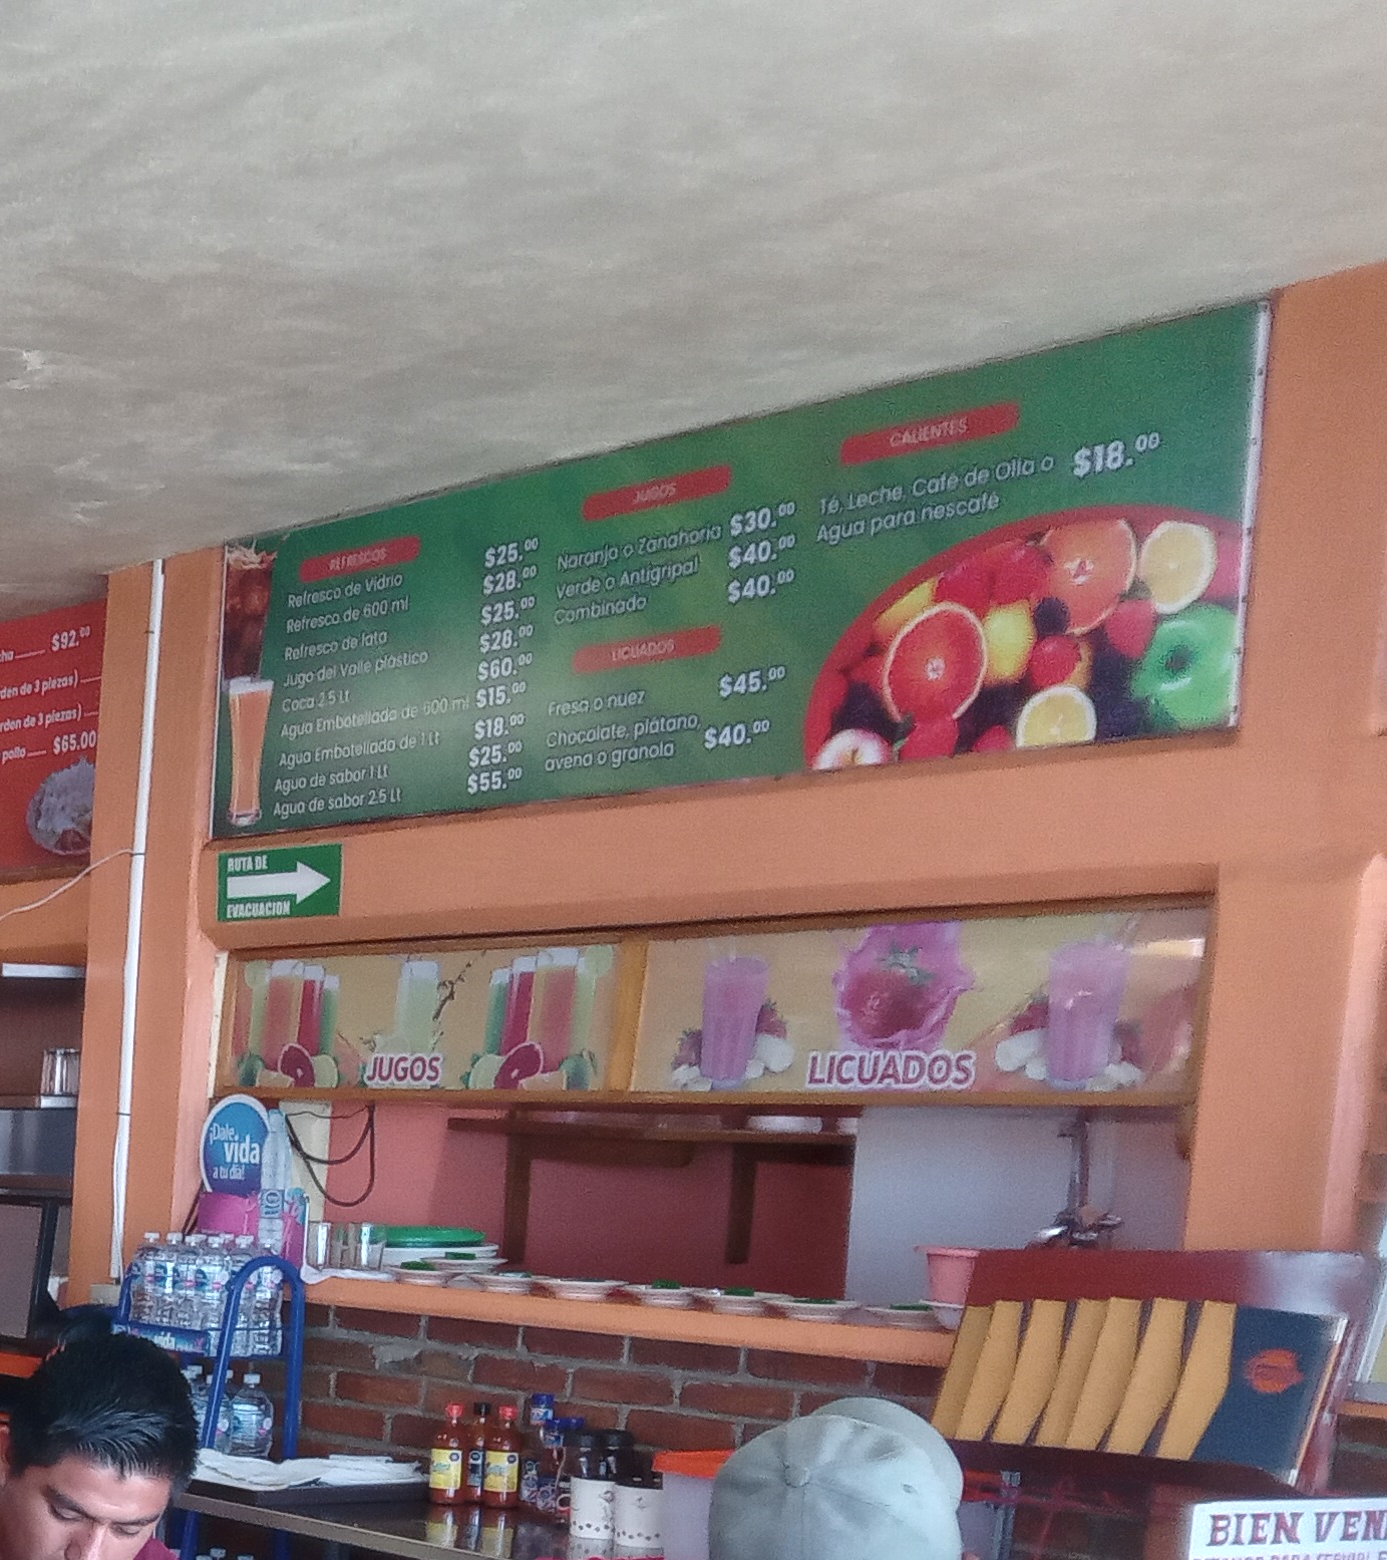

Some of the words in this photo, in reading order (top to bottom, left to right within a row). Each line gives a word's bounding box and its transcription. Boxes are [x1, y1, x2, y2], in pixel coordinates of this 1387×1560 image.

[890, 417, 968, 447] CALIENTES
[912, 471, 960, 497] Café
[964, 467, 989, 487] de
[995, 457, 1036, 482] Olla
[1040, 455, 1055, 472] o
[633, 483, 678, 503] JUGOS
[730, 501, 796, 537] $30.00
[816, 520, 866, 546] Agua
[870, 512, 916, 535] para
[920, 492, 1000, 523] nescafé
[484, 537, 539, 569] $25.00
[557, 545, 619, 571] Naranja
[622, 544, 633, 558] o
[637, 524, 722, 554] Zanahoria
[728, 534, 796, 570] $40.00
[287, 586, 342, 608] Refresco
[345, 583, 361, 597] de
[364, 573, 403, 593] Vidrio
[556, 576, 601, 599] Verde
[605, 576, 616, 591] o
[619, 557, 699, 587] Antigripal
[727, 569, 795, 604] $40.00
[286, 613, 339, 634] Refresco
[344, 607, 360, 621] de
[363, 598, 388, 618] 600
[391, 596, 410, 612] ml
[554, 596, 648, 626] Combinado
[284, 641, 338, 661] Refresco
[342, 635, 359, 651] de
[361, 631, 388, 645] lata
[612, 639, 675, 661] LICUADOS
[283, 669, 314, 689] Jugo
[317, 665, 337, 679] del
[340, 660, 372, 677] Valle
[477, 653, 533, 681] $60.00
[719, 666, 786, 698] $45.00
[19, 683, 32, 696] de
[282, 696, 315, 713] Coca
[547, 700, 591, 717] Fresa
[593, 697, 603, 711] o
[607, 690, 646, 708] nuez
[281, 722, 313, 740] Agua
[316, 709, 397, 731] Embotellada
[401, 705, 419, 719] de
[704, 719, 770, 750] $40.00
[2, 746, 26, 765] pollo
[53, 730, 97, 756] $65.00
[278, 751, 312, 770] Agua
[315, 738, 397, 762] Embotellada
[399, 734, 417, 749] de
[545, 751, 593, 772] avena
[596, 751, 607, 765] o
[611, 741, 675, 768] granola
[274, 778, 307, 797] Agua
[310, 772, 326, 787] de
[329, 768, 368, 786] sabor
[467, 767, 523, 795] $55.00
[273, 801, 306, 820] Agua
[308, 796, 325, 813] de
[328, 792, 365, 810] sabor
[227, 855, 253, 873] RUTA
[254, 854, 268, 870] DE
[226, 900, 291, 919] EVACUACION
[365, 1053, 444, 1084] JUGOS
[806, 1049, 977, 1088] LICUADOS
[223, 1133, 261, 1164] vida
[212, 1168, 219, 1179] a
[219, 1165, 229, 1179] tu
[1206, 1512, 1304, 1547] BIEN
